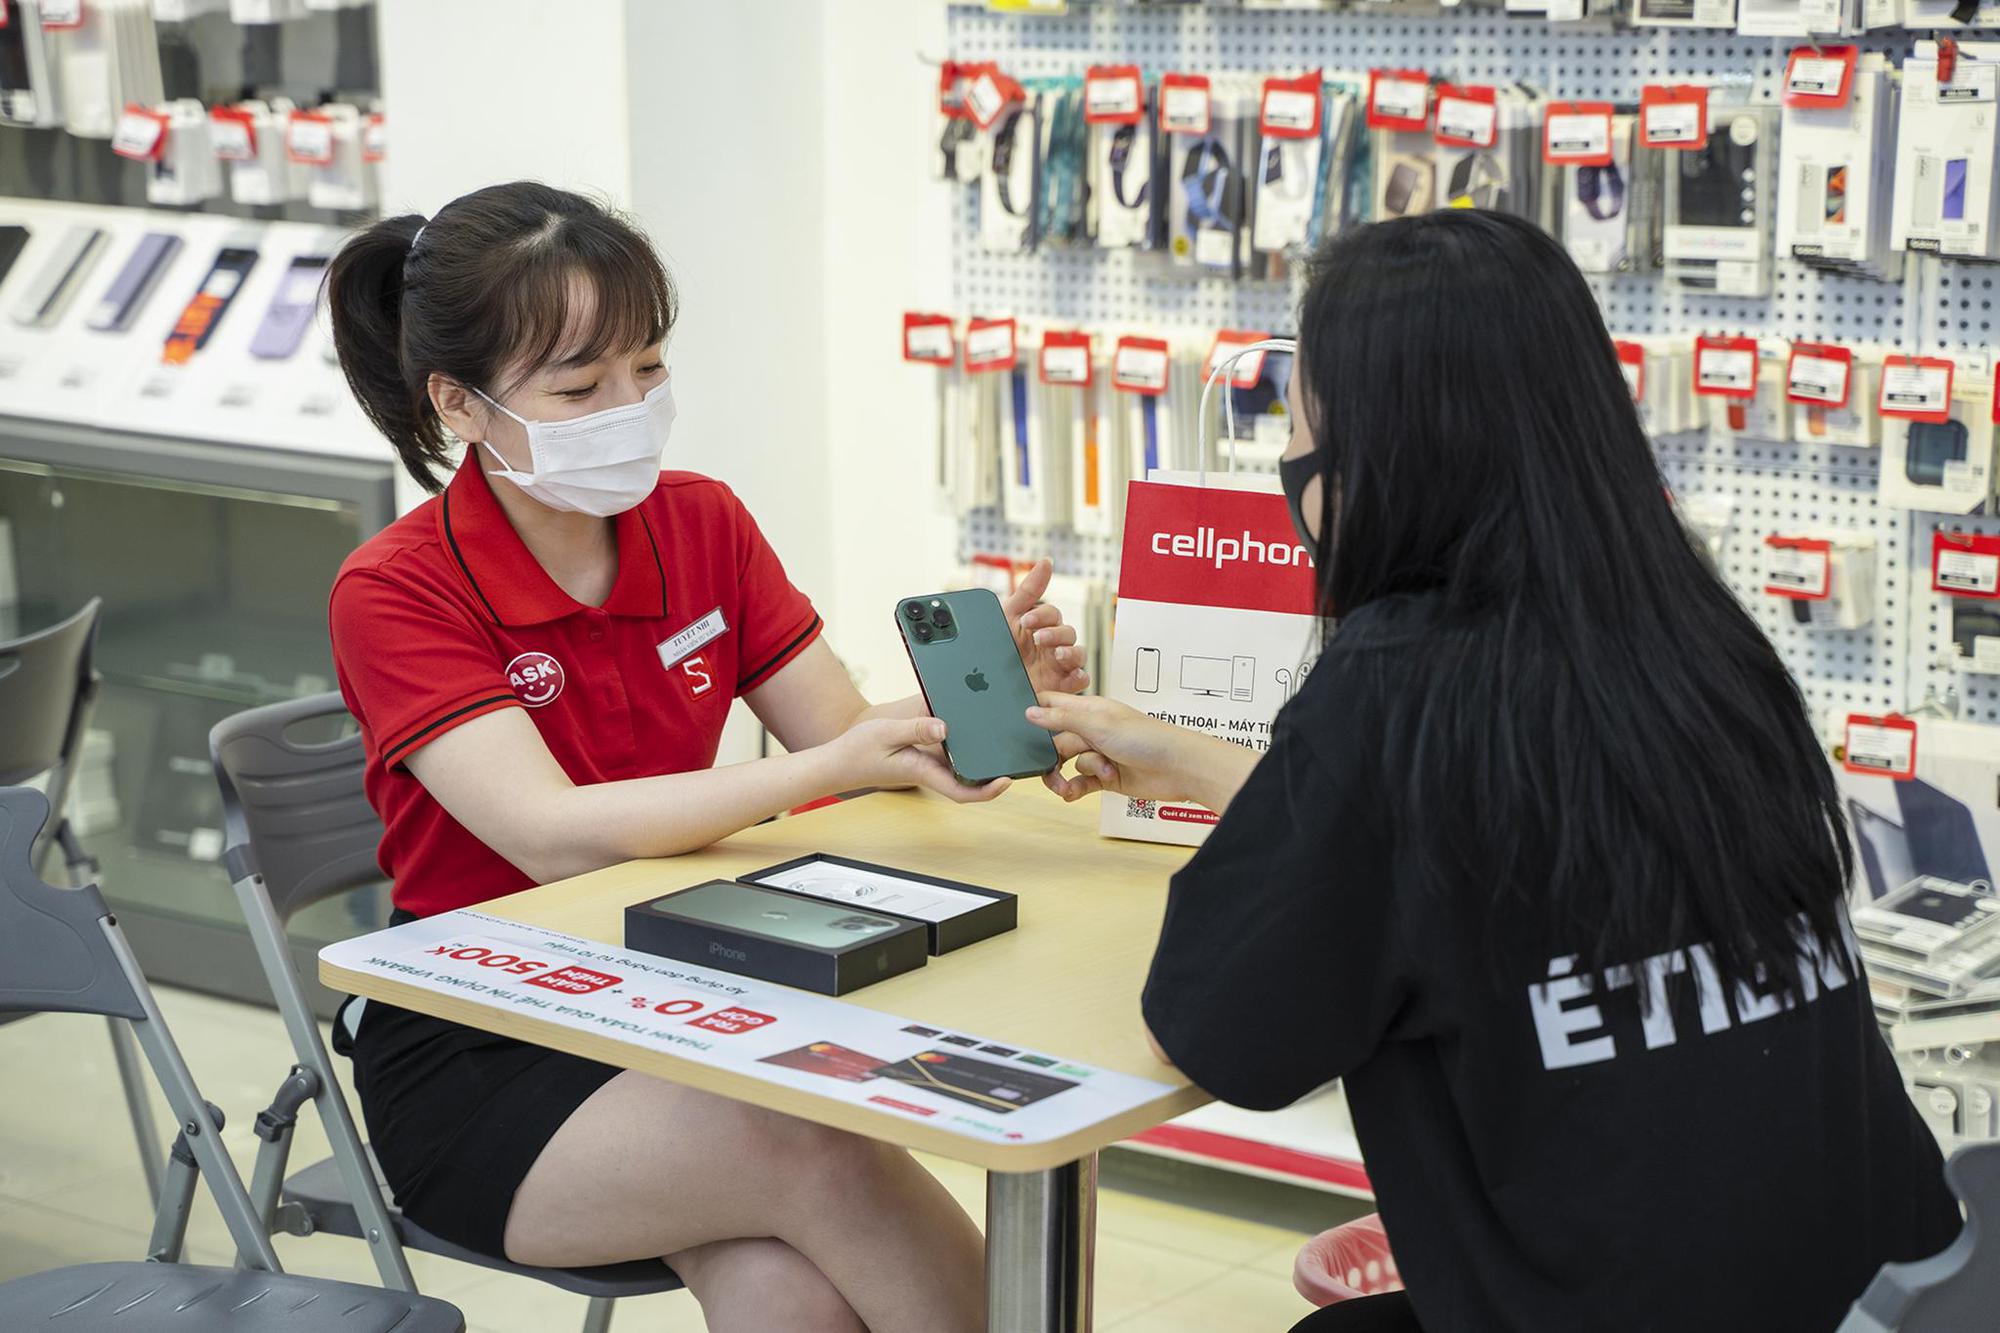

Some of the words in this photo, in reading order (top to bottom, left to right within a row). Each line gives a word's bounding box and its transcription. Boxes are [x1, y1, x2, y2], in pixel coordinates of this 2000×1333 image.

[1152, 526, 1315, 569] cellphon
[509, 659, 557, 688] ASK
[1179, 715, 1218, 731] THOẠI
[1229, 718, 1256, 732] MÁY
[1161, 809, 1178, 817] Quét
[709, 941, 746, 962] iPhone
[366, 957, 433, 978] VPBANK
[616, 957, 656, 974] hàng
[435, 974, 490, 992] DỤNG
[539, 975, 591, 991] GIẢM
[560, 969, 611, 986] THÊM
[685, 975, 725, 990] dụng
[486, 987, 519, 1000] TÍN
[555, 1003, 596, 1020] QUA
[717, 1010, 764, 1025] GÓP
[597, 1015, 648, 1034] TOÁN
[700, 1016, 741, 1031] TRẢ
[648, 1030, 715, 1051] THANH
